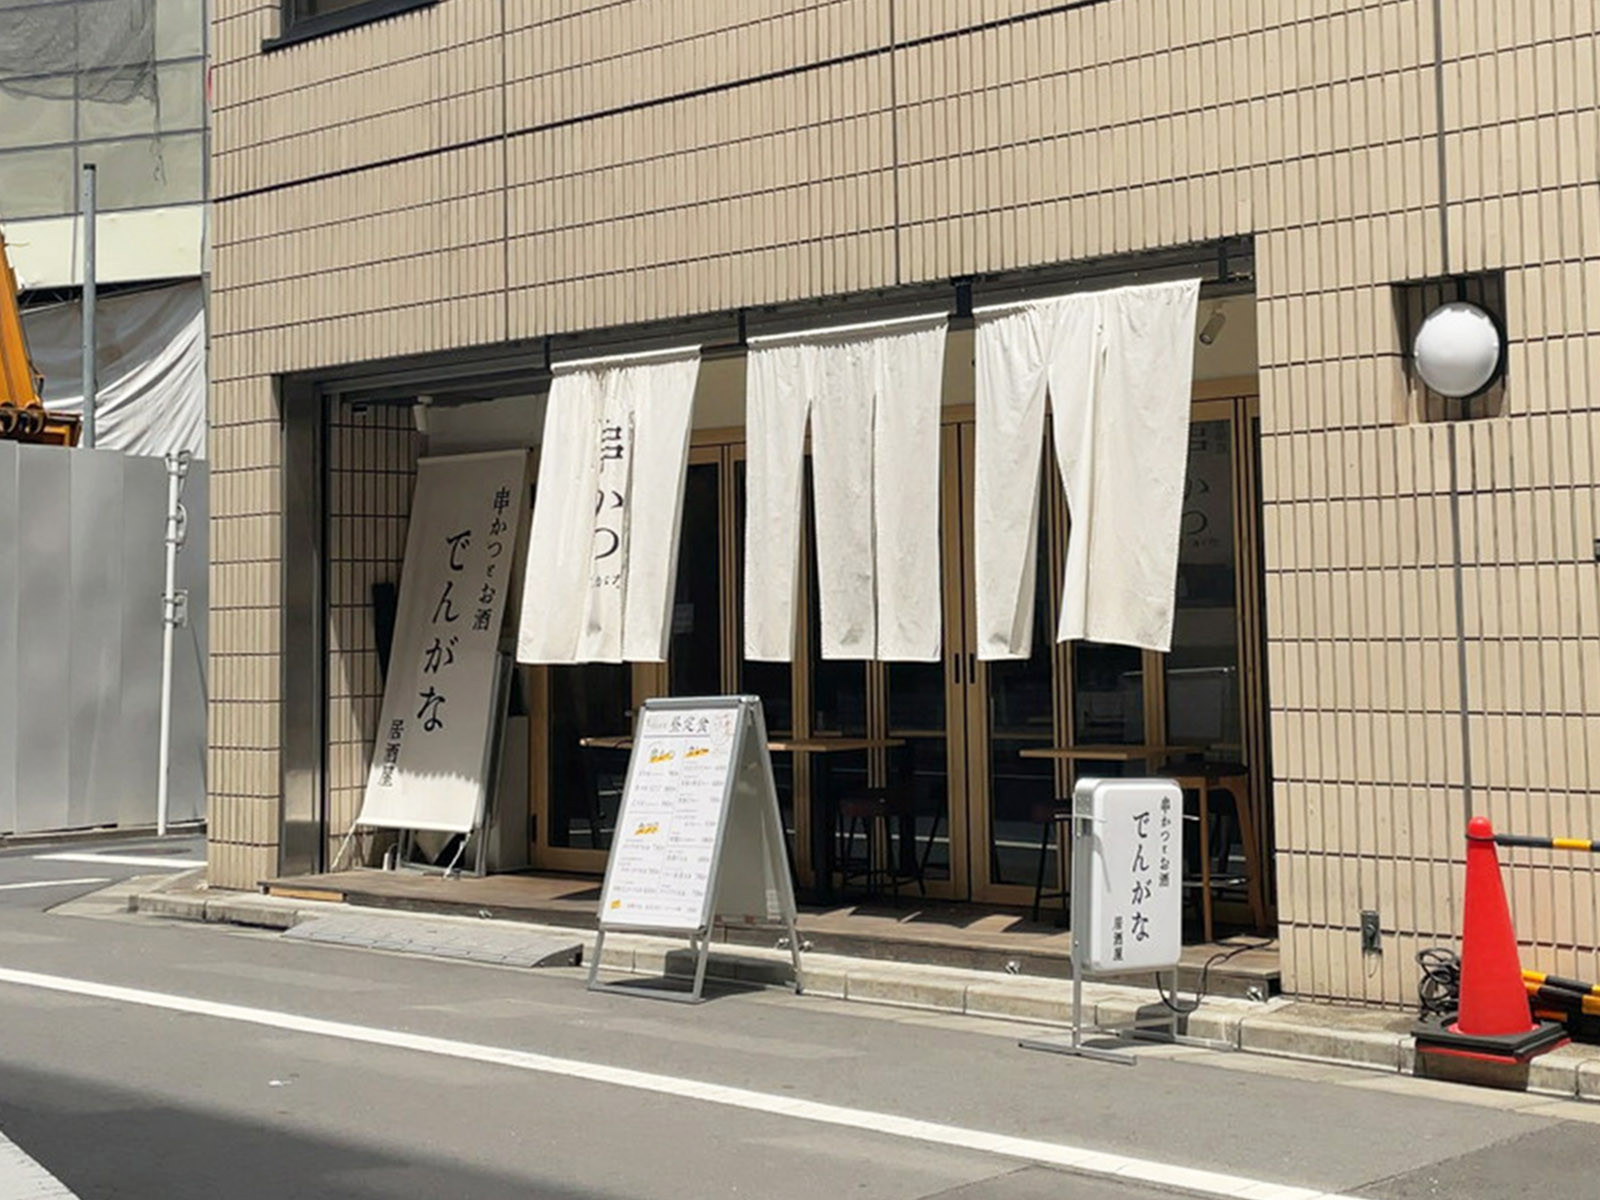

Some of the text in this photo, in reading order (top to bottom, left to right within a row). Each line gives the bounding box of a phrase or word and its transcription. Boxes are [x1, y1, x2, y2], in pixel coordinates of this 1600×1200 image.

[471, 486, 511, 632] 串かつとお酒
[416, 529, 472, 733] でんがな
[1131, 811, 1152, 943] でんがな
[1158, 796, 1172, 888] 串かつとお酒
[1112, 915, 1125, 962] 居酒屋
